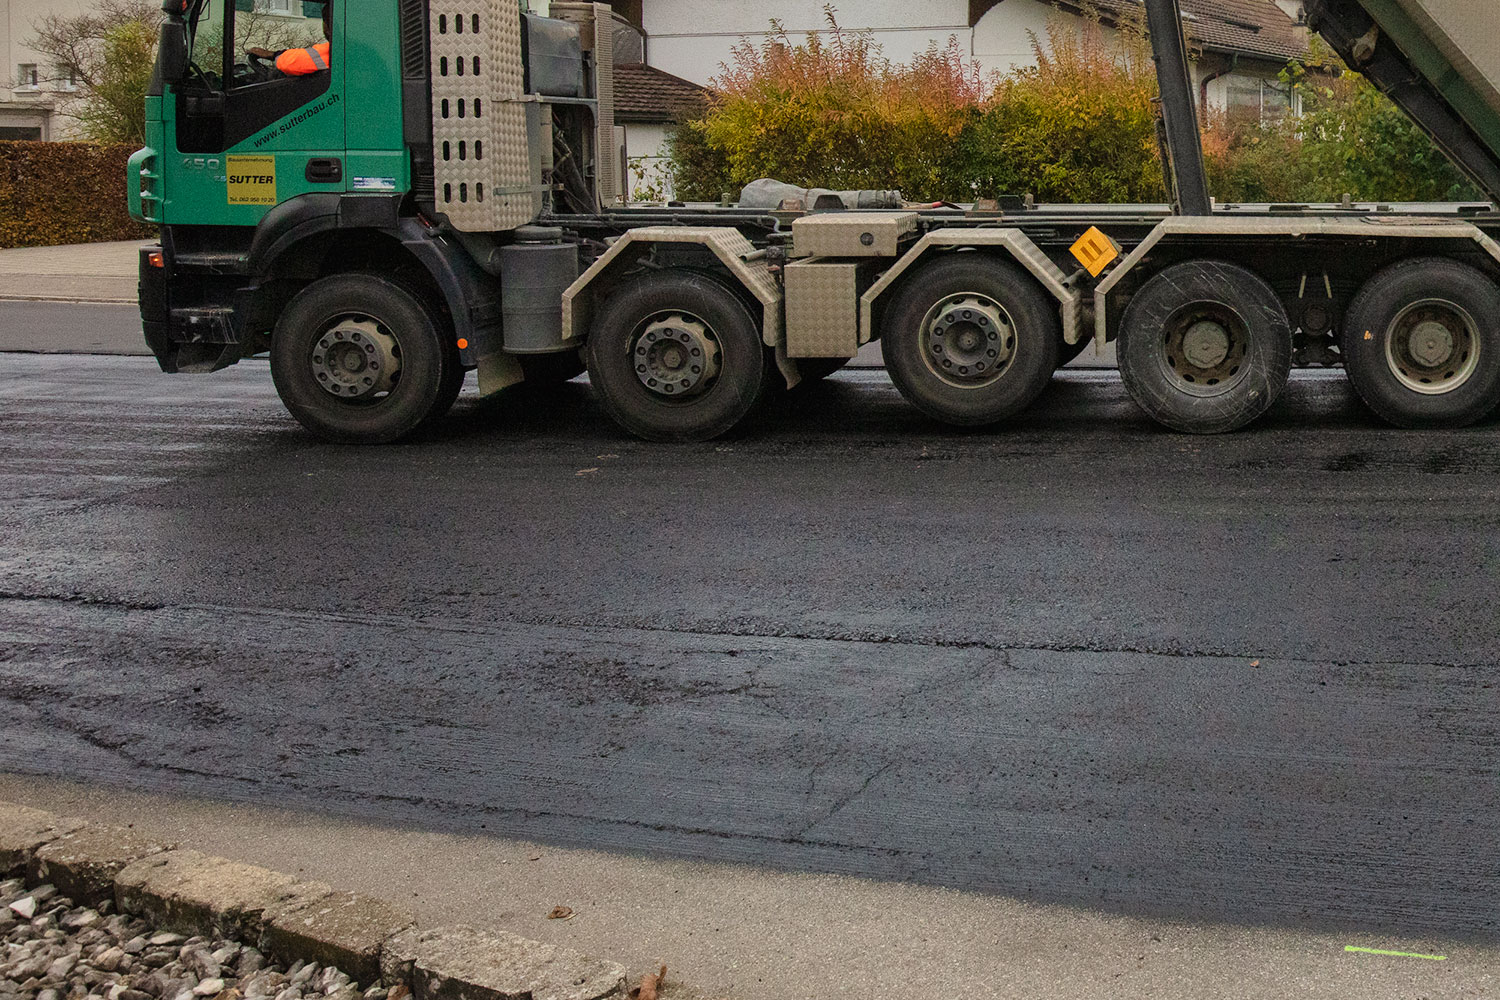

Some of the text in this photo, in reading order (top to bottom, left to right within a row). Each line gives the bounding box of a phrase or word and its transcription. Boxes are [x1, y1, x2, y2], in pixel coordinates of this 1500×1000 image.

[254, 93, 340, 148] www.sutterbau.ch
[183, 158, 220, 170] 450
[229, 175, 274, 184] SUTTER
